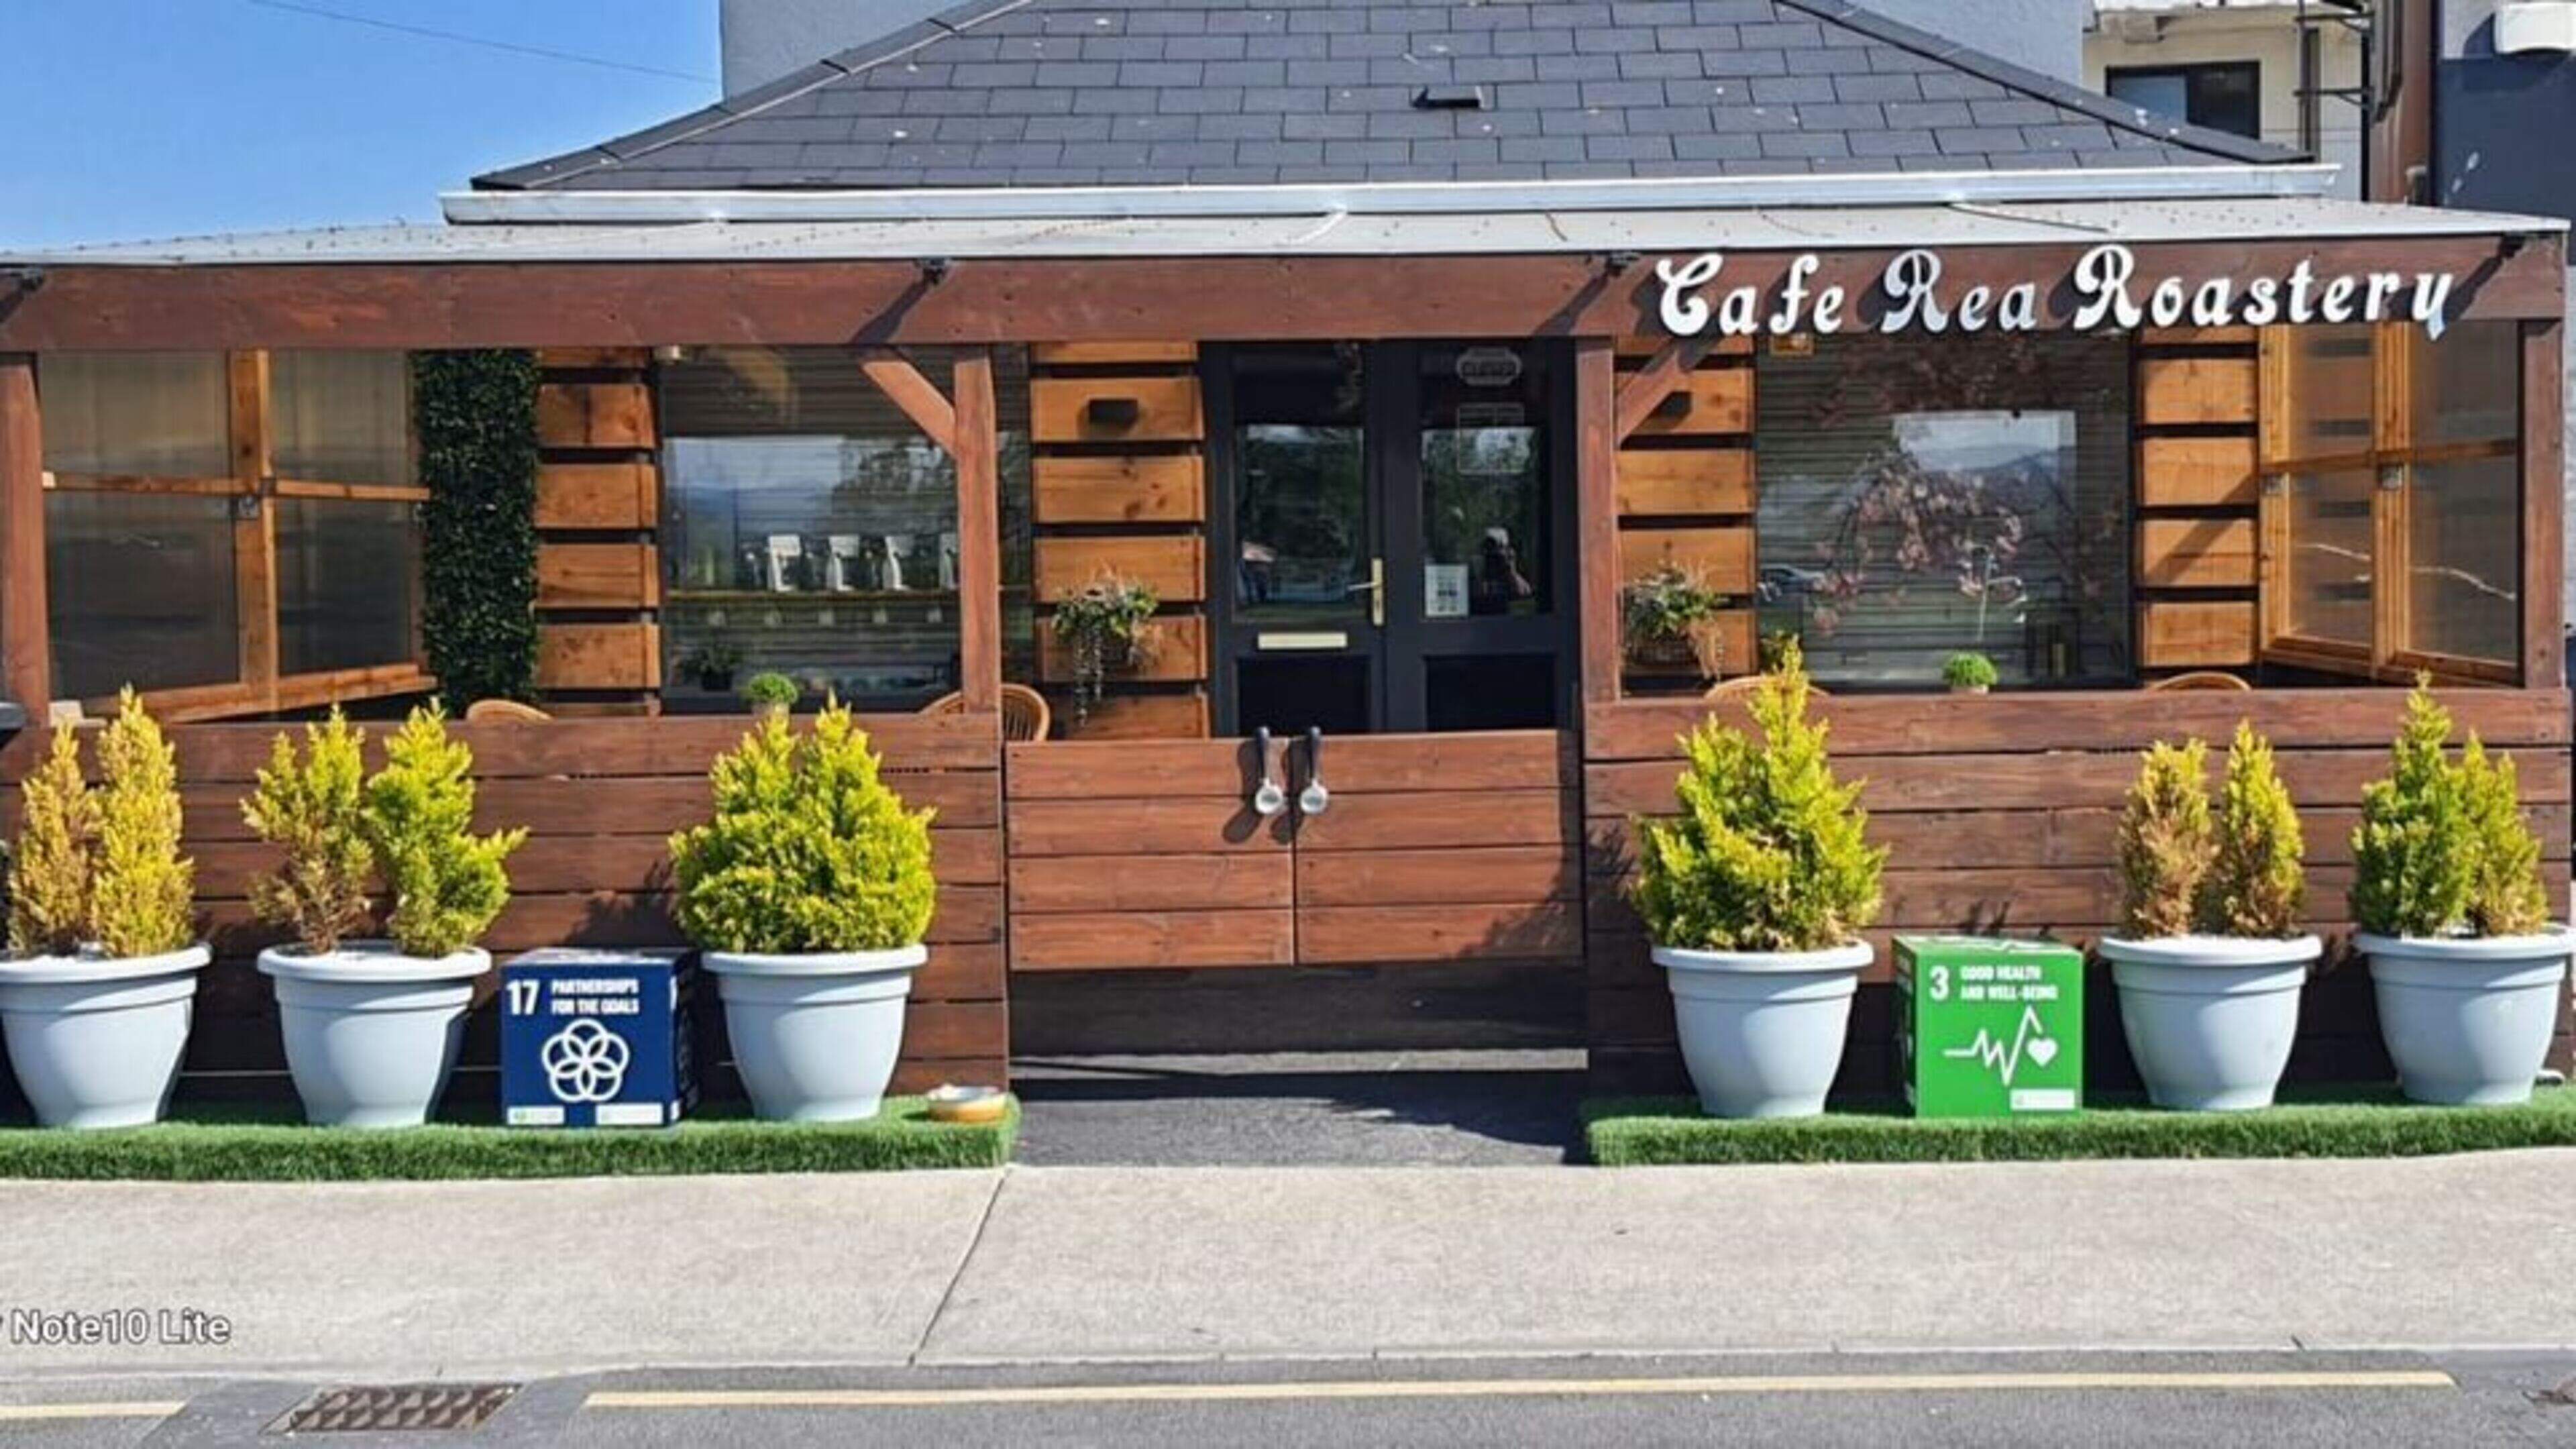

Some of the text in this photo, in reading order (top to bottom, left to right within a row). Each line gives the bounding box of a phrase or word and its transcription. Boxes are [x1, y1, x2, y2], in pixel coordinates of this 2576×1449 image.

[1655, 244, 2453, 340] Cafe Rea Roastery
[1960, 965, 2042, 981] GOOD HEALTH
[551, 979, 639, 994] PARTNERSHIPS
[1929, 965, 1949, 1001] 3
[506, 979, 539, 1015] 17
[1960, 984, 2058, 1000] AND WELL-BEING
[551, 998, 639, 1014] FOR THE GOALS
